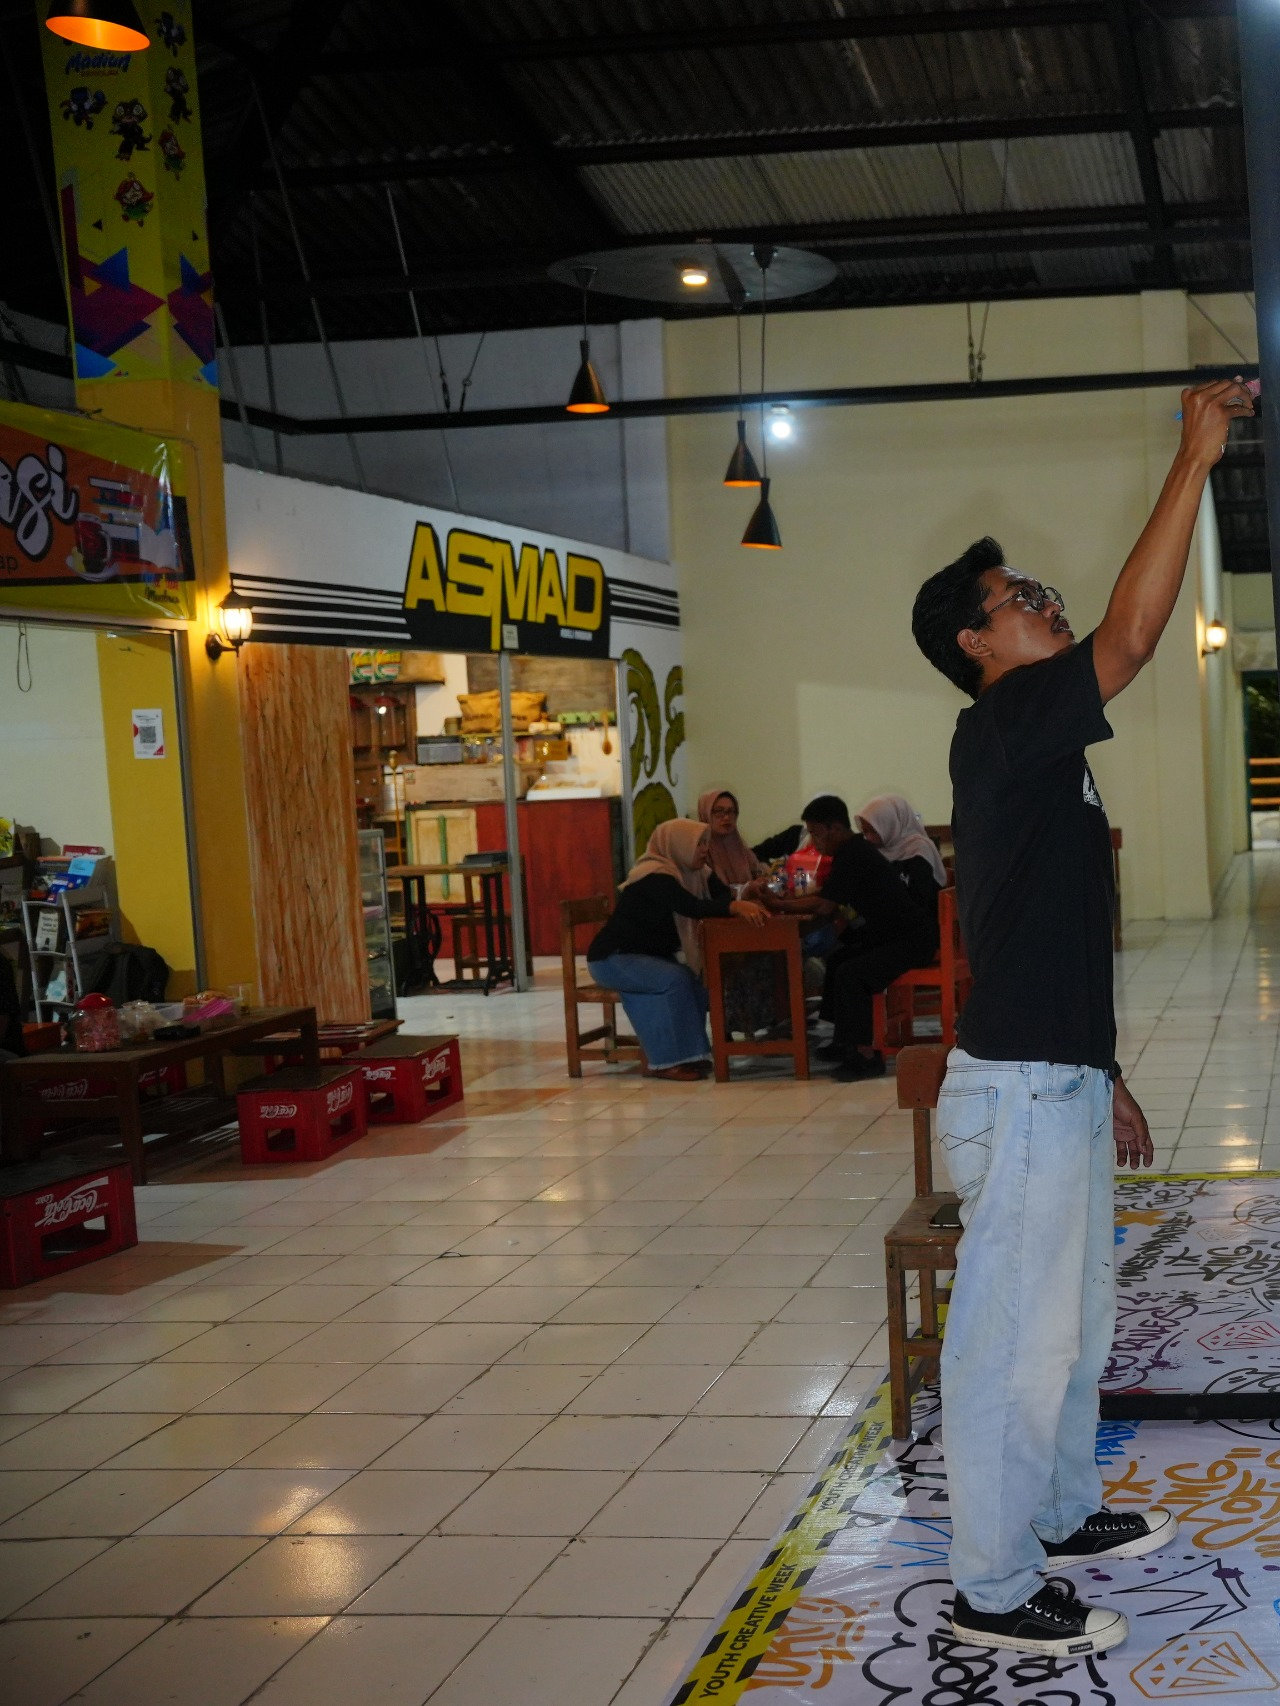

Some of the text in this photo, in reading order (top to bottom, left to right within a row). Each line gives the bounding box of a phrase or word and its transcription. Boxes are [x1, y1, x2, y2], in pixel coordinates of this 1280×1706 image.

[404, 520, 604, 651] ASMAD
[817, 1421, 885, 1511] YOUTH CREATIVE WEEK
[699, 1563, 798, 1698] YOUTH CREATIVE WEEK
